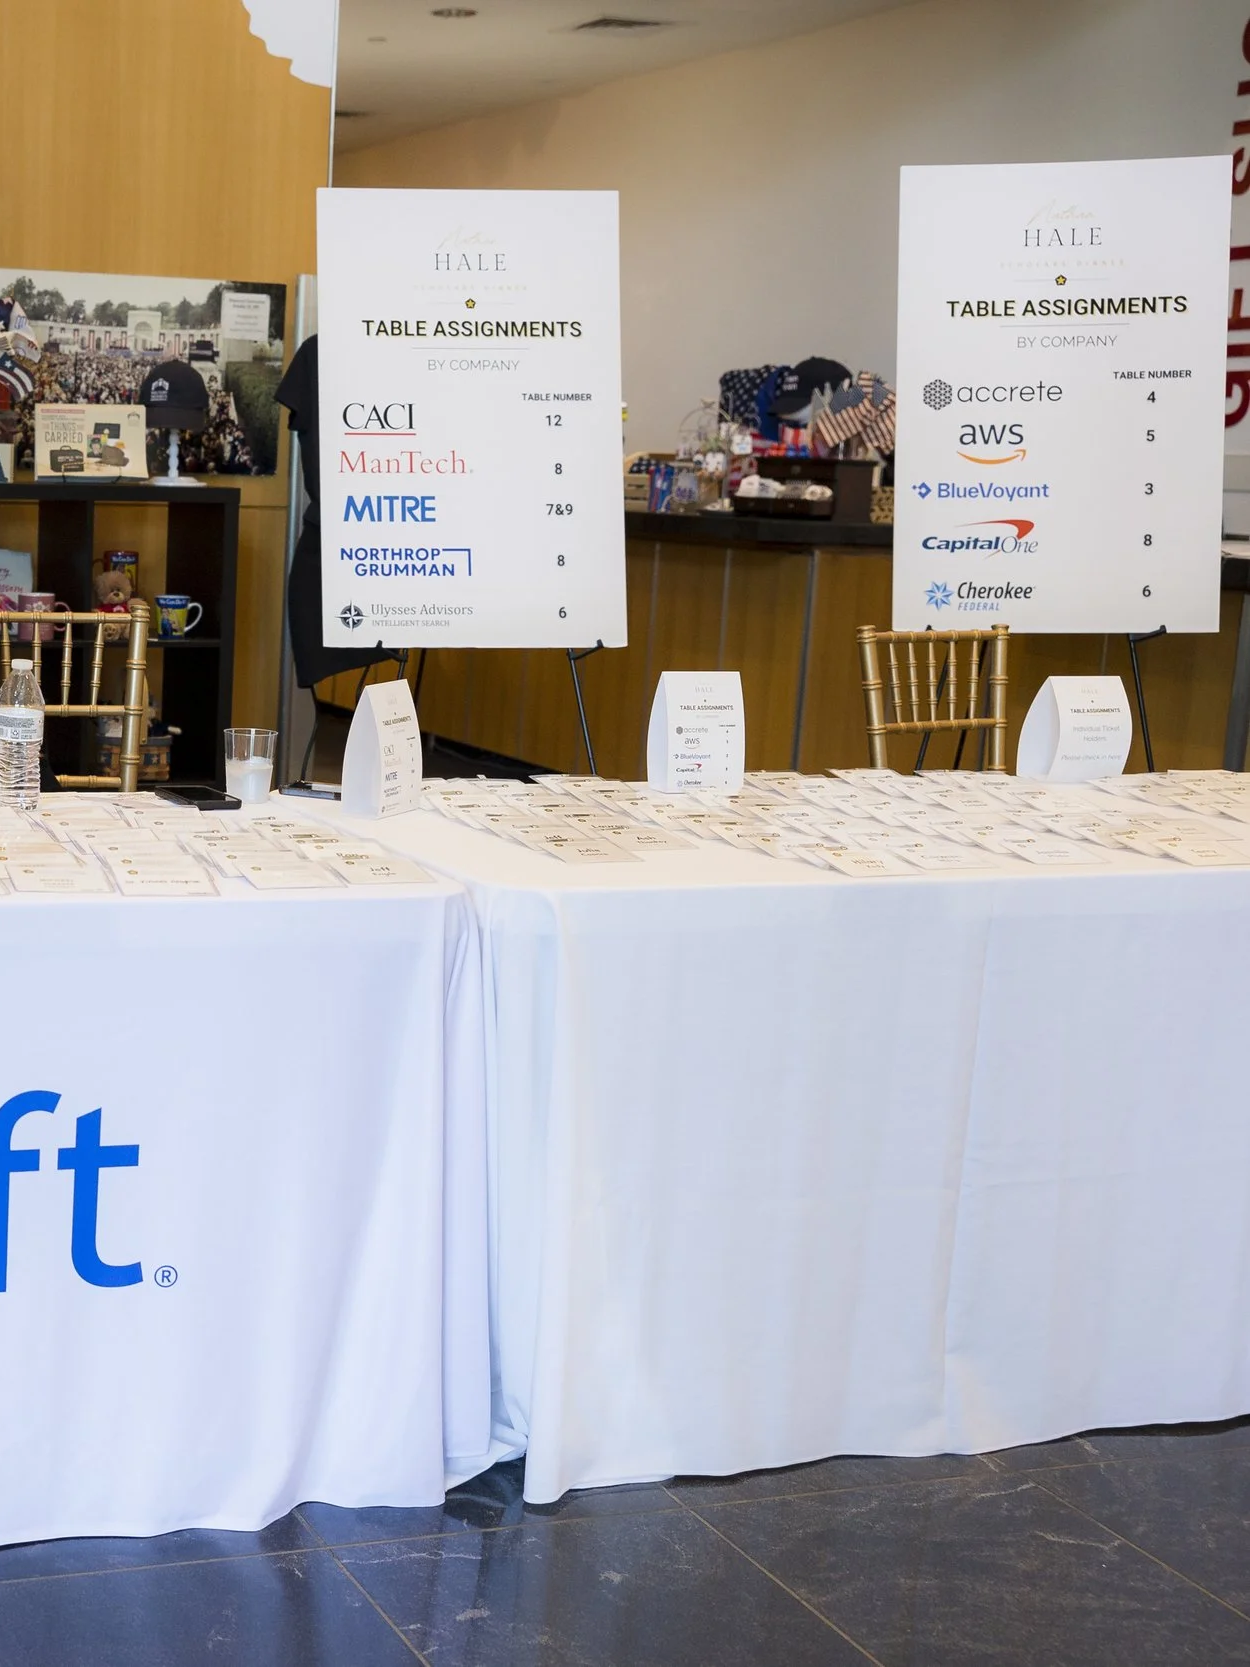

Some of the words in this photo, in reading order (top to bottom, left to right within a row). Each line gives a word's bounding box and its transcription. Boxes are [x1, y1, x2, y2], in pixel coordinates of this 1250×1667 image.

[1023, 226, 1103, 247] HALE
[434, 253, 508, 272] HALE
[946, 299, 1016, 318] TABLE
[1021, 295, 1188, 317] ASSIGNMENTS
[361, 319, 428, 337] TABLE
[432, 320, 583, 338] ASSIGNMENTS
[1016, 336, 1037, 349] BY
[1040, 335, 1119, 349] COMPANY
[427, 358, 446, 371] BY
[449, 358, 521, 372] COMPANY
[1112, 371, 1146, 380] TABLE
[1148, 369, 1193, 380] NUMBER
[521, 392, 551, 401] TABLE
[553, 392, 593, 402] NUMBER
[956, 380, 1063, 403] accrete
[1146, 391, 1157, 404] 4
[342, 402, 416, 431] CACI
[545, 414, 563, 427] 12
[44, 431, 84, 444] CARRIED
[958, 423, 1025, 446] aws
[1145, 430, 1156, 443] 5
[338, 450, 467, 475] ManTech
[554, 463, 563, 476] 8
[937, 482, 1050, 502] BlueVoyant
[1144, 483, 1154, 496] 3
[343, 495, 437, 523] MITRE
[545, 503, 574, 517] 7&9
[1142, 534, 1153, 547] 8
[340, 547, 441, 561] NORTHROP
[557, 555, 566, 568] 8
[354, 563, 456, 577] GRUMMAN
[956, 581, 1034, 600] Cherokee
[1141, 585, 1151, 598] 6
[370, 604, 416, 617] Ulysses
[419, 603, 474, 616] Advisors
[558, 607, 567, 620] 6
[957, 602, 1001, 611] FEDERAL
[371, 619, 420, 628] INTELLIGENT
[421, 619, 451, 628] SEARCH
